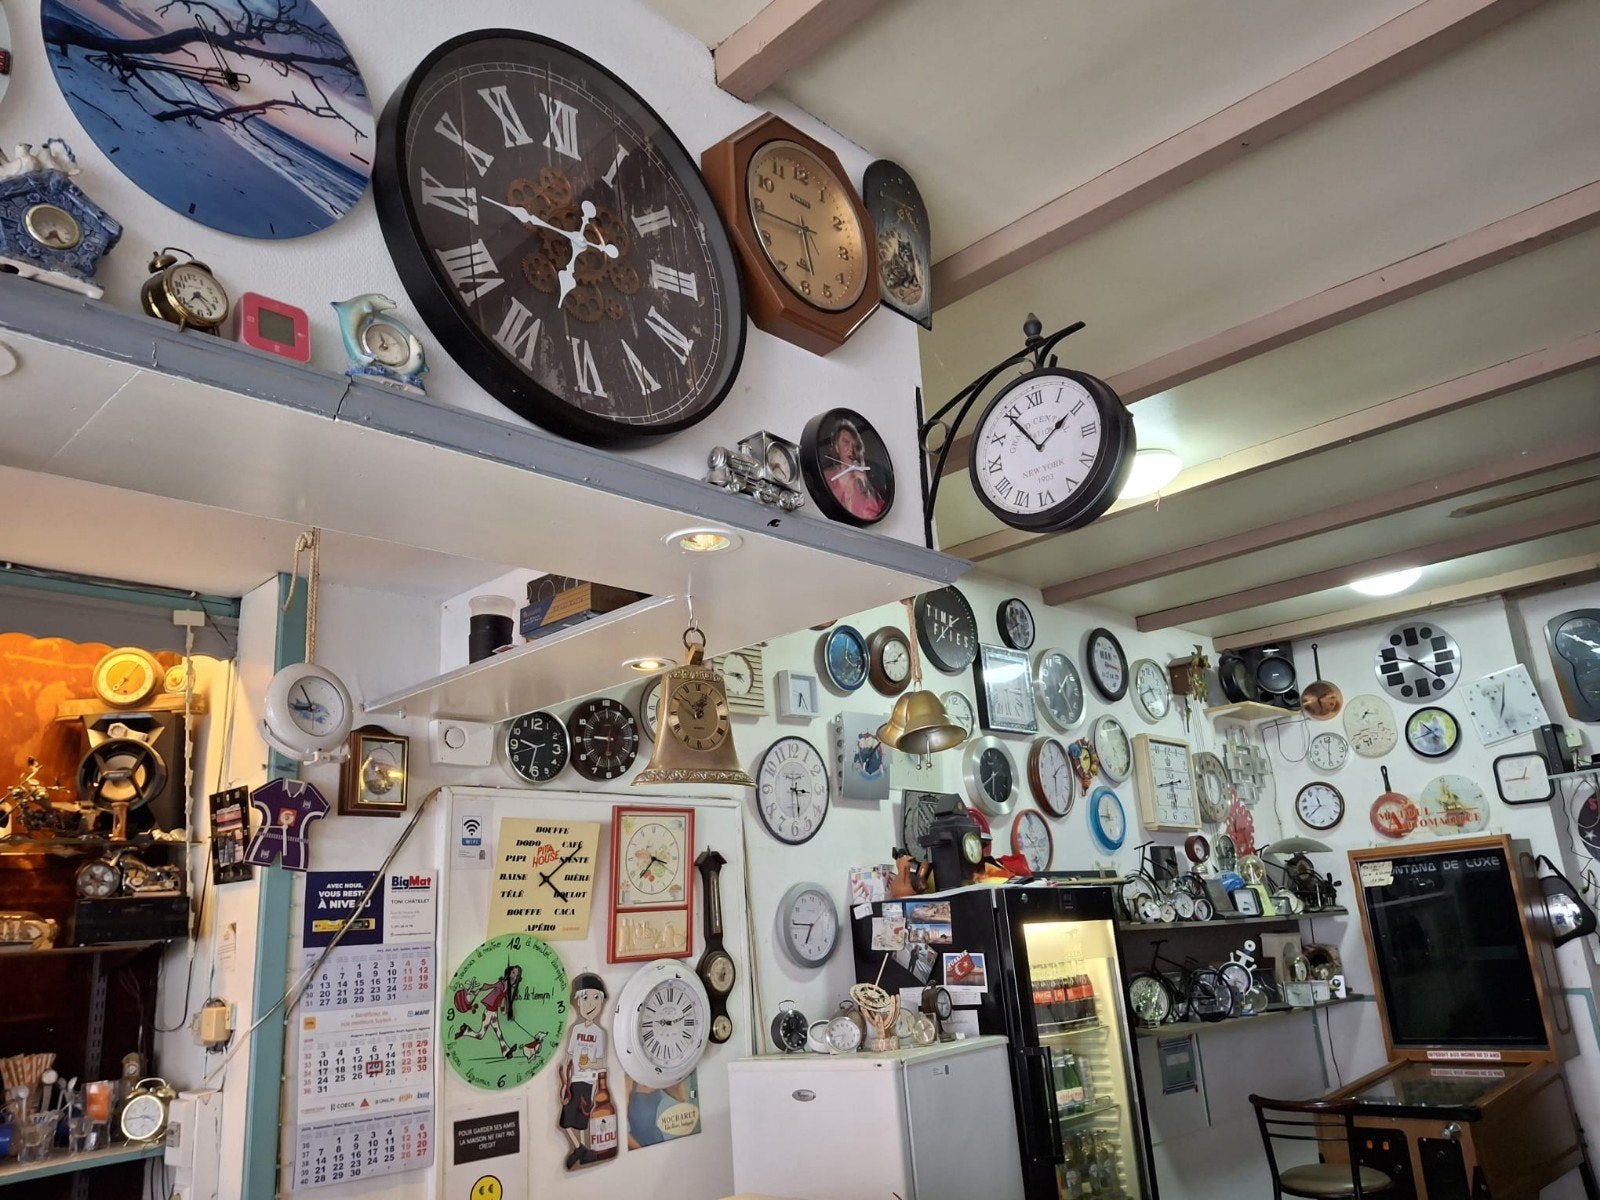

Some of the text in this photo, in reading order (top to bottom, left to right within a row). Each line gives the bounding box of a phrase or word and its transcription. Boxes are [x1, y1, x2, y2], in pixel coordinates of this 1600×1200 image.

[478, 85, 533, 148] XI
[539, 93, 580, 161] XII
[434, 112, 494, 176] X
[602, 144, 629, 187] I
[772, 160, 785, 179] 11
[757, 174, 774, 192] 10
[793, 166, 809, 185] 12
[632, 205, 671, 237] II
[832, 216, 843, 230] 2
[839, 247, 849, 260] 3
[436, 238, 504, 307] VIII
[651, 260, 698, 302] III
[801, 280, 811, 295] 6
[822, 283, 832, 298] 5
[492, 296, 541, 370] VII
[644, 306, 694, 365] IV
[570, 337, 607, 398] VI
[621, 339, 661, 396] V
[1025, 390, 1044, 409] XII
[1055, 388, 1063, 403] I
[1003, 405, 1022, 426] XI
[1070, 400, 1085, 415] II
[1081, 421, 1097, 438] III
[992, 432, 1006, 447] X
[989, 456, 1003, 474] IX
[1023, 458, 1065, 479] NEW YORK
[1080, 453, 1095, 469] IV
[995, 477, 1014, 500] VIII
[1066, 478, 1079, 492] V
[1013, 490, 1029, 507] VII
[1038, 490, 1055, 506] VI
[927, 604, 953, 628] TIME
[934, 623, 968, 648] FLIES
[531, 718, 543, 730] 12
[510, 739, 518, 750] 9
[552, 744, 561, 754] 3
[787, 743, 799, 759] 12
[774, 748, 785, 764] 11
[802, 749, 810, 763] 1
[530, 766, 539, 777] 6
[764, 761, 777, 777] 10
[810, 764, 822, 776] 2
[762, 783, 773, 795] 9
[815, 783, 825, 795] 3
[766, 802, 777, 820] 8
[813, 804, 823, 818] 4
[778, 816, 787, 832] 7
[791, 820, 799, 836] 6
[803, 816, 813, 831] 5
[537, 844, 554, 856] PITA
[532, 850, 560, 868] HOUSE
[1443, 860, 1459, 869] DE
[1466, 856, 1500, 868] LUXE
[391, 876, 431, 889] BigMat
[318, 899, 327, 909] À
[525, 923, 556, 931] APÉRO
[507, 937, 521, 950] 12
[447, 1008, 455, 1021] 9
[554, 1001, 565, 1013] 3
[577, 1034, 597, 1042] FILOU
[497, 1074, 507, 1088] 6
[473, 1127, 493, 1135] GARDER
[591, 1132, 617, 1144] FILOU
[467, 1136, 486, 1144] MAISON
